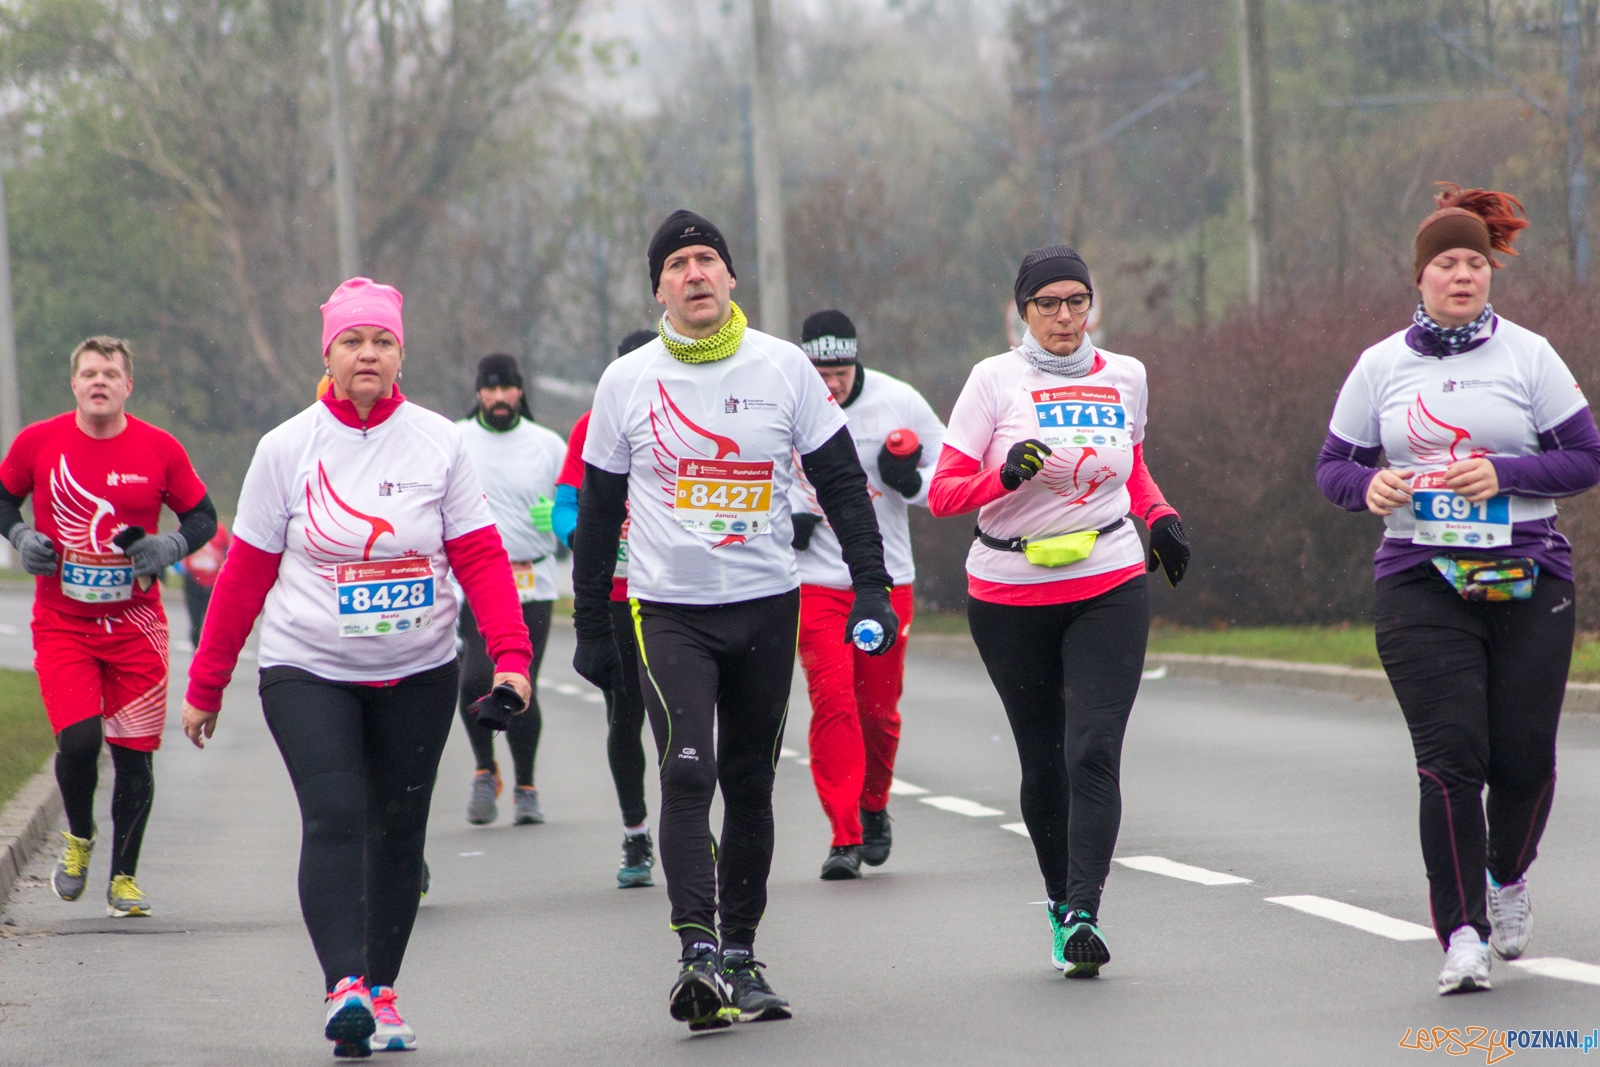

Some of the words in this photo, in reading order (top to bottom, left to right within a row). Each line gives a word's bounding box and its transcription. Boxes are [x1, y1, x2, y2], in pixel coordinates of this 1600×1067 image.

[1050, 405, 1117, 425] 1713
[678, 489, 687, 498] D
[690, 483, 764, 509] 8427
[1414, 501, 1422, 511] E
[1431, 495, 1487, 520] 691
[71, 566, 126, 586] 5723
[340, 595, 349, 605] E
[352, 583, 425, 611] 8428
